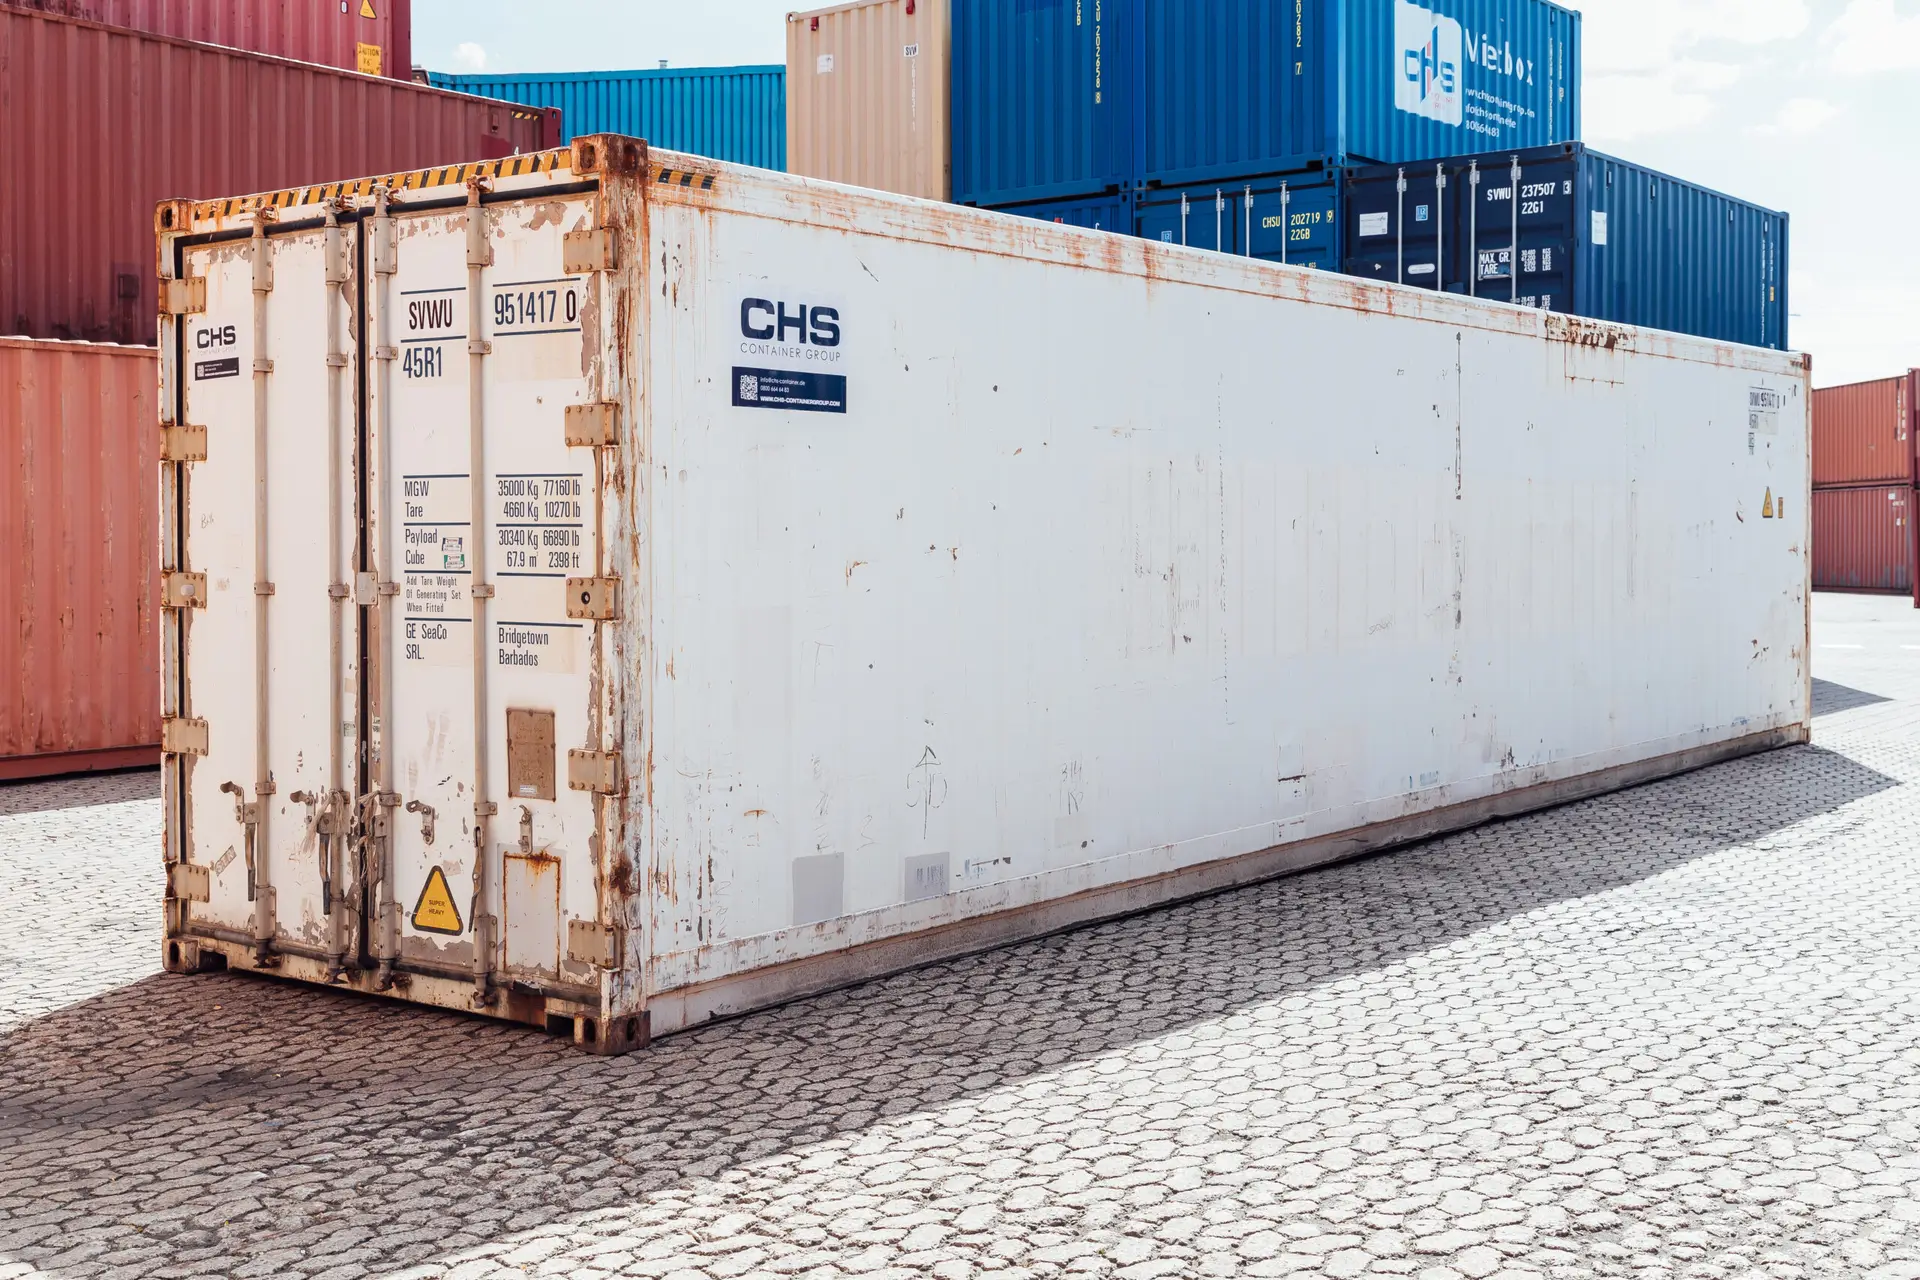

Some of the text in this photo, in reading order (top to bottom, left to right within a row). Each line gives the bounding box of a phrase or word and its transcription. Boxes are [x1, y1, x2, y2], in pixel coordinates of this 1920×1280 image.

[1295, 62, 1302, 75] 7
[1095, 92, 1101, 104] 8
[1486, 181, 1571, 201] SVWU 237507 3
[1521, 201, 1543, 215] 22G1
[1262, 210, 1333, 228] CHSU 202719 9
[1290, 228, 1311, 241] 22GB
[1479, 263, 1499, 275] TARE
[408, 289, 577, 330] SVWU 951417 0
[740, 297, 840, 347] CHS
[197, 325, 236, 349] CHS
[740, 342, 841, 362] CONTAINER GROUP
[402, 346, 443, 379] 45R1
[759, 395, 841, 407] WWW.CHS-CONTAINERGROUP.COM
[404, 479, 581, 500] MGW 35000 Kg 77160 lb
[405, 502, 581, 521] Tare 4660 Kg 10270 lb
[405, 529, 438, 547] Payload
[498, 530, 525, 546] 30340
[527, 530, 539, 550] Kg
[543, 530, 570, 546] 66890
[571, 529, 580, 546] lb
[405, 550, 425, 565] Cube
[506, 551, 525, 567] 67.9
[548, 552, 570, 568] 2398
[406, 576, 457, 587] Add Tare Weight
[406, 589, 461, 601] Of Generating Set
[406, 603, 444, 613] When Fitted
[406, 623, 447, 640] GE SeaCo
[498, 628, 549, 648] Bridgetown
[405, 644, 425, 660] SRL.
[499, 649, 538, 666] Barbados
[428, 899, 445, 907] SUPER
[428, 908, 445, 916] HEAVY
